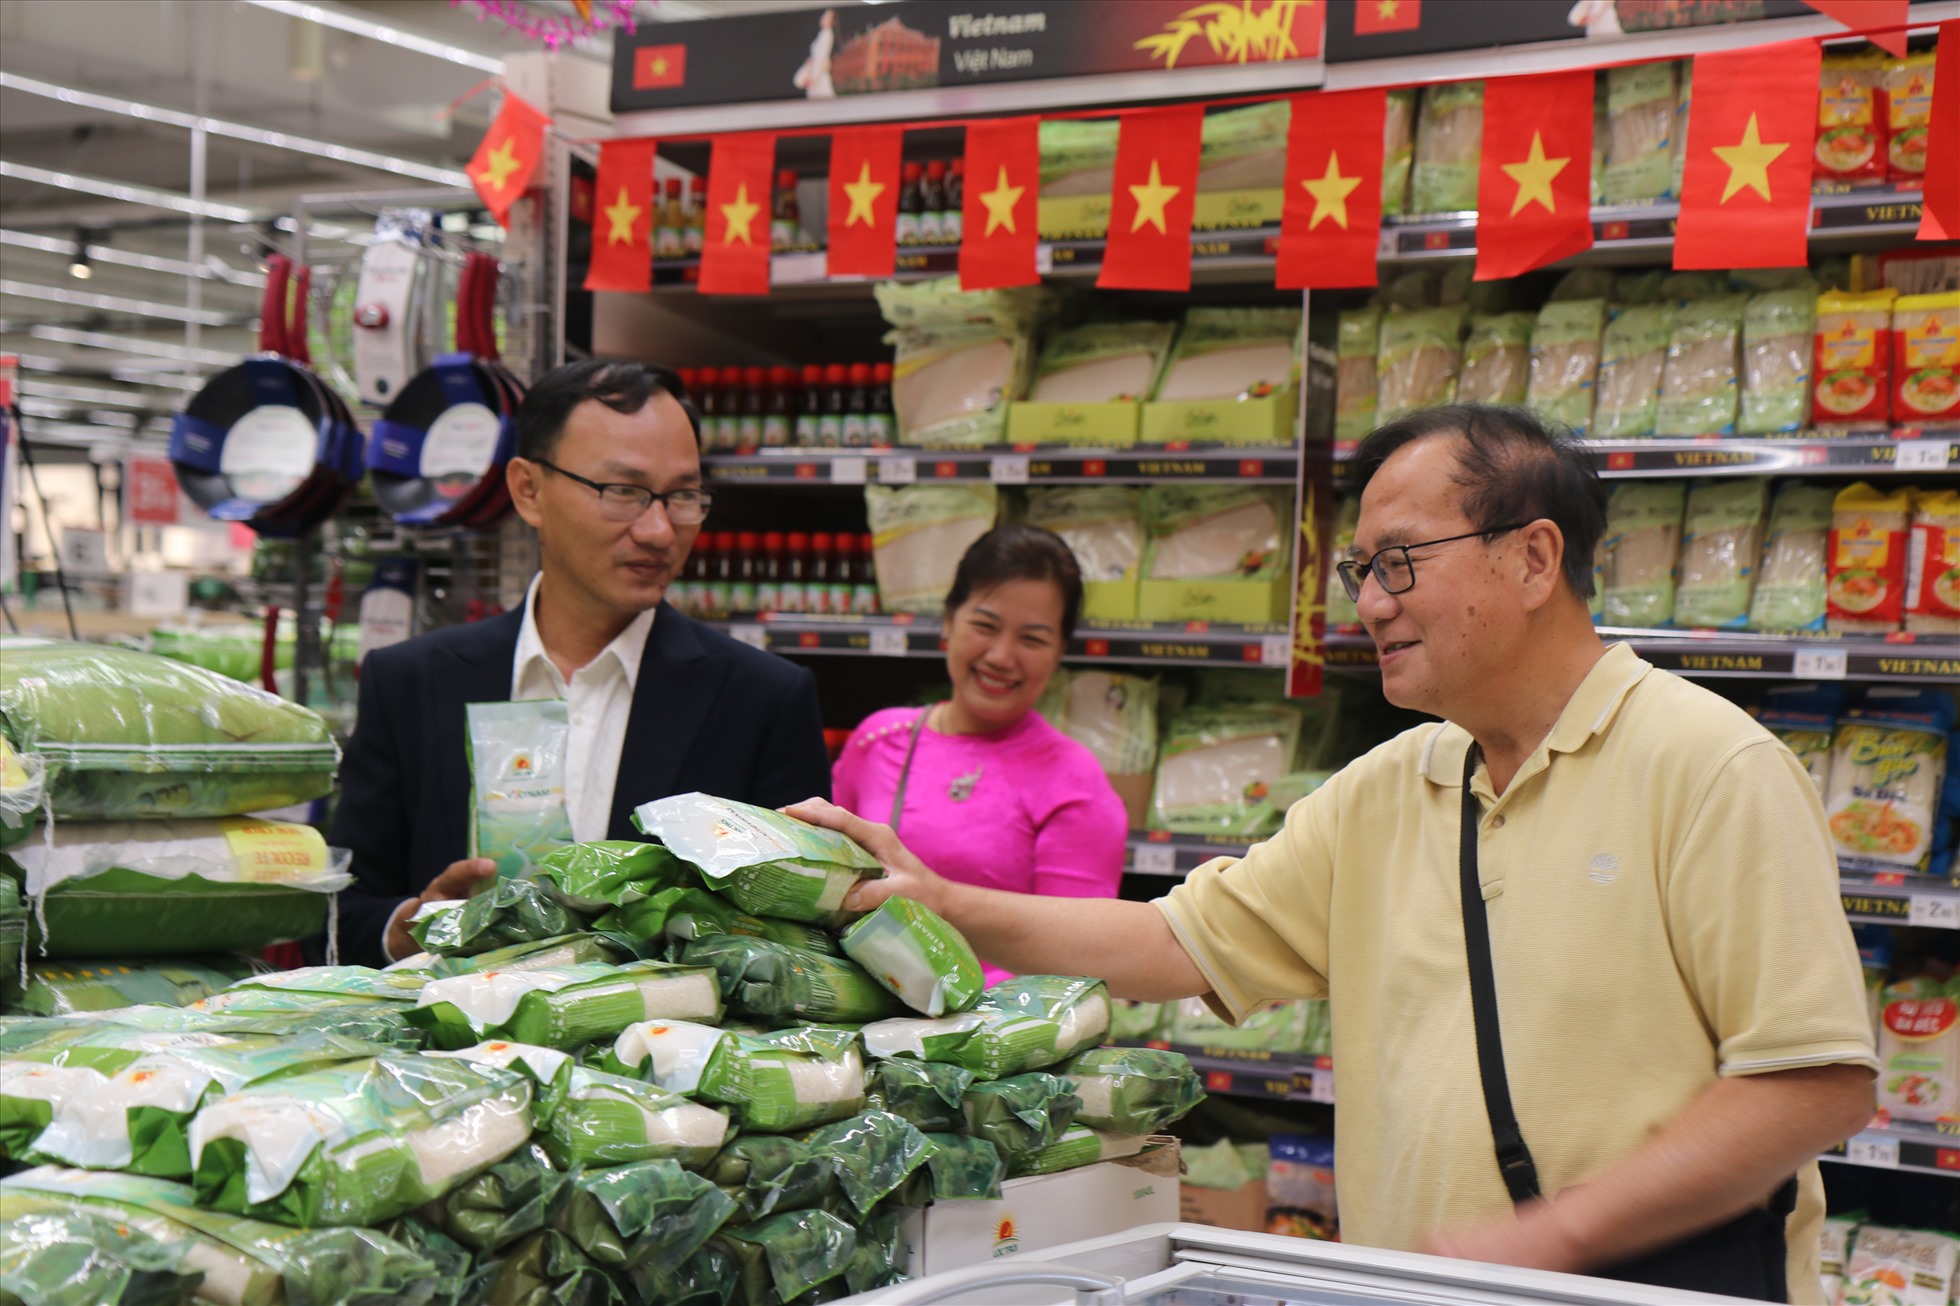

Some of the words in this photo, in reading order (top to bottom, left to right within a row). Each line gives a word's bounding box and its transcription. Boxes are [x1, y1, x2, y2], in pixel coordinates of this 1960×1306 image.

[948, 12, 1047, 40] Vietnam
[953, 48, 989, 74] Việt
[990, 47, 1034, 69] Nam
[1865, 203, 1923, 221] VIETN
[1673, 450, 1757, 467] VIETNAM
[1138, 460, 1206, 475] VIETNAM
[1141, 644, 1210, 658] VIETNAM
[1680, 655, 1763, 670] VIETNAM
[1841, 897, 1911, 915] VIETNA
